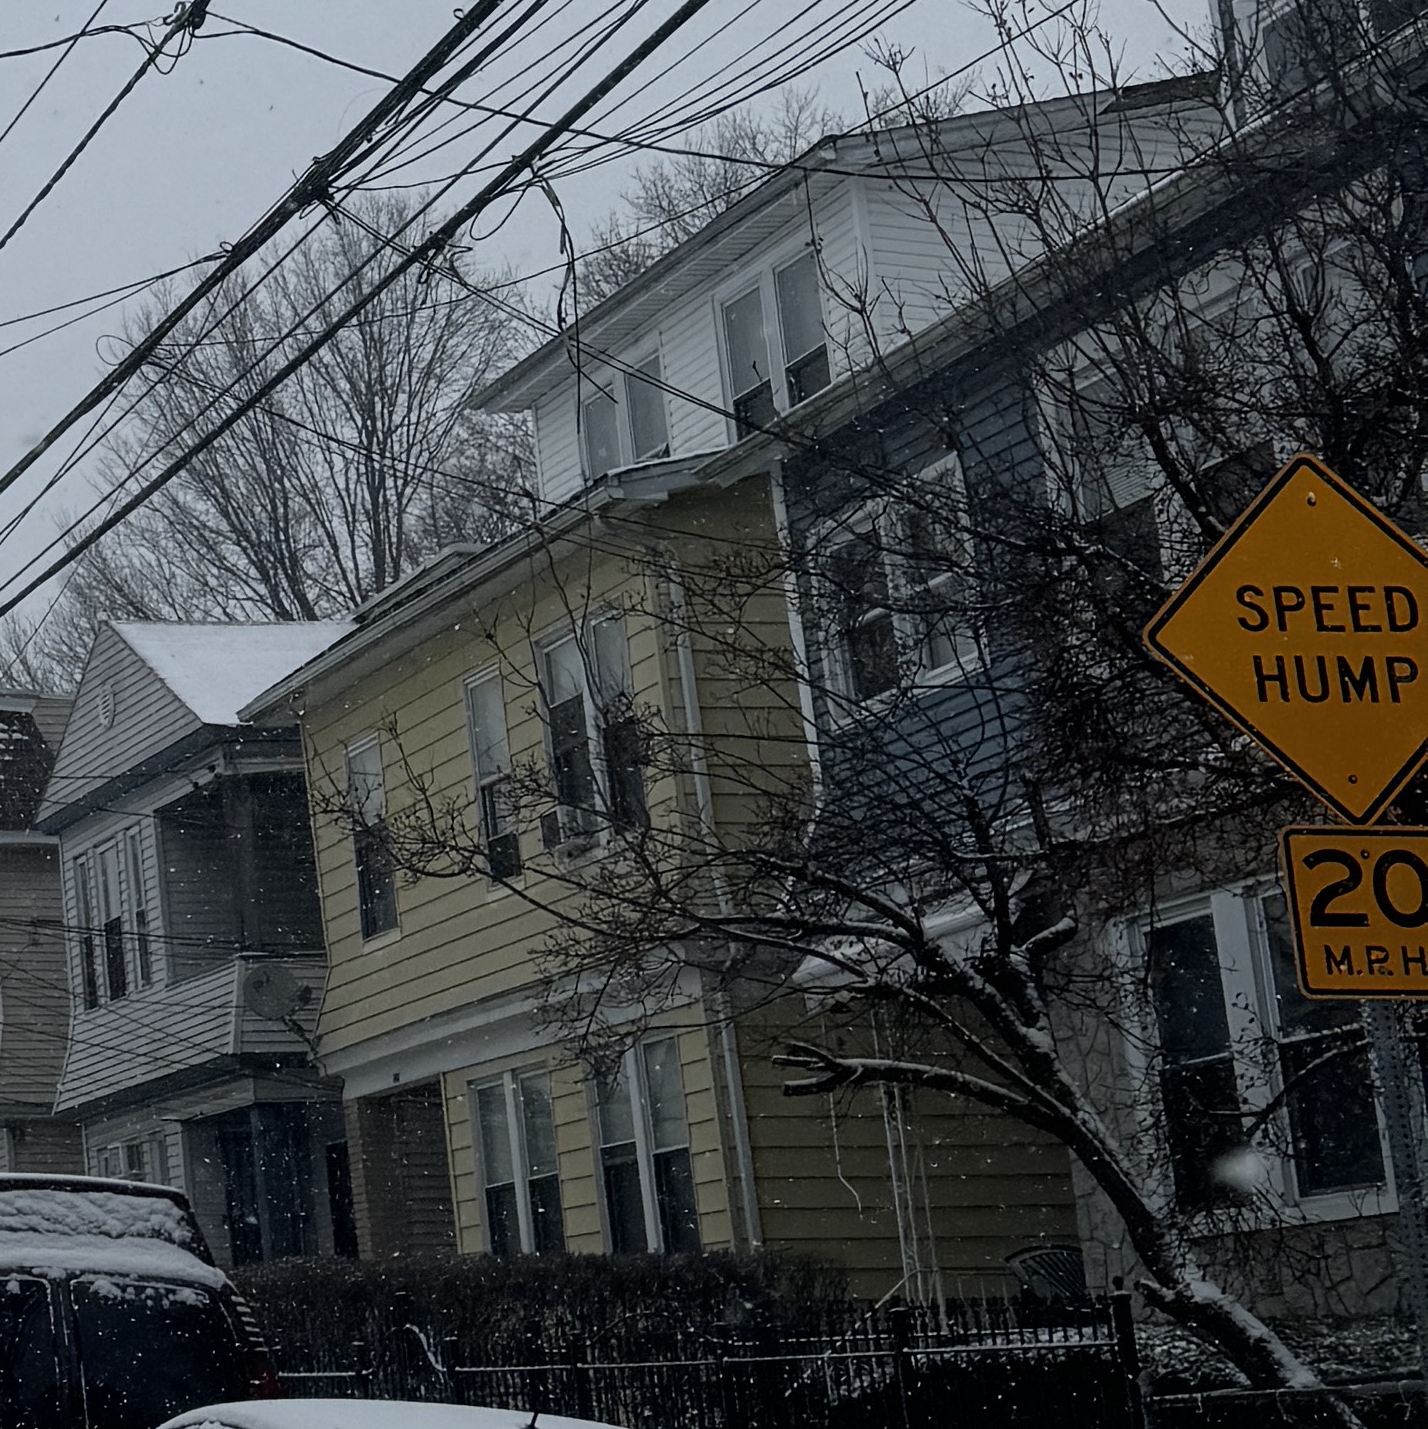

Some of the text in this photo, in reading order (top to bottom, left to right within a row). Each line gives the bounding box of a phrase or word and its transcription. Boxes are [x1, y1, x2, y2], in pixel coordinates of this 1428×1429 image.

[1236, 584, 1420, 633] SPEED
[1252, 654, 1420, 704] HUMP
[1301, 848, 1428, 929] 20
